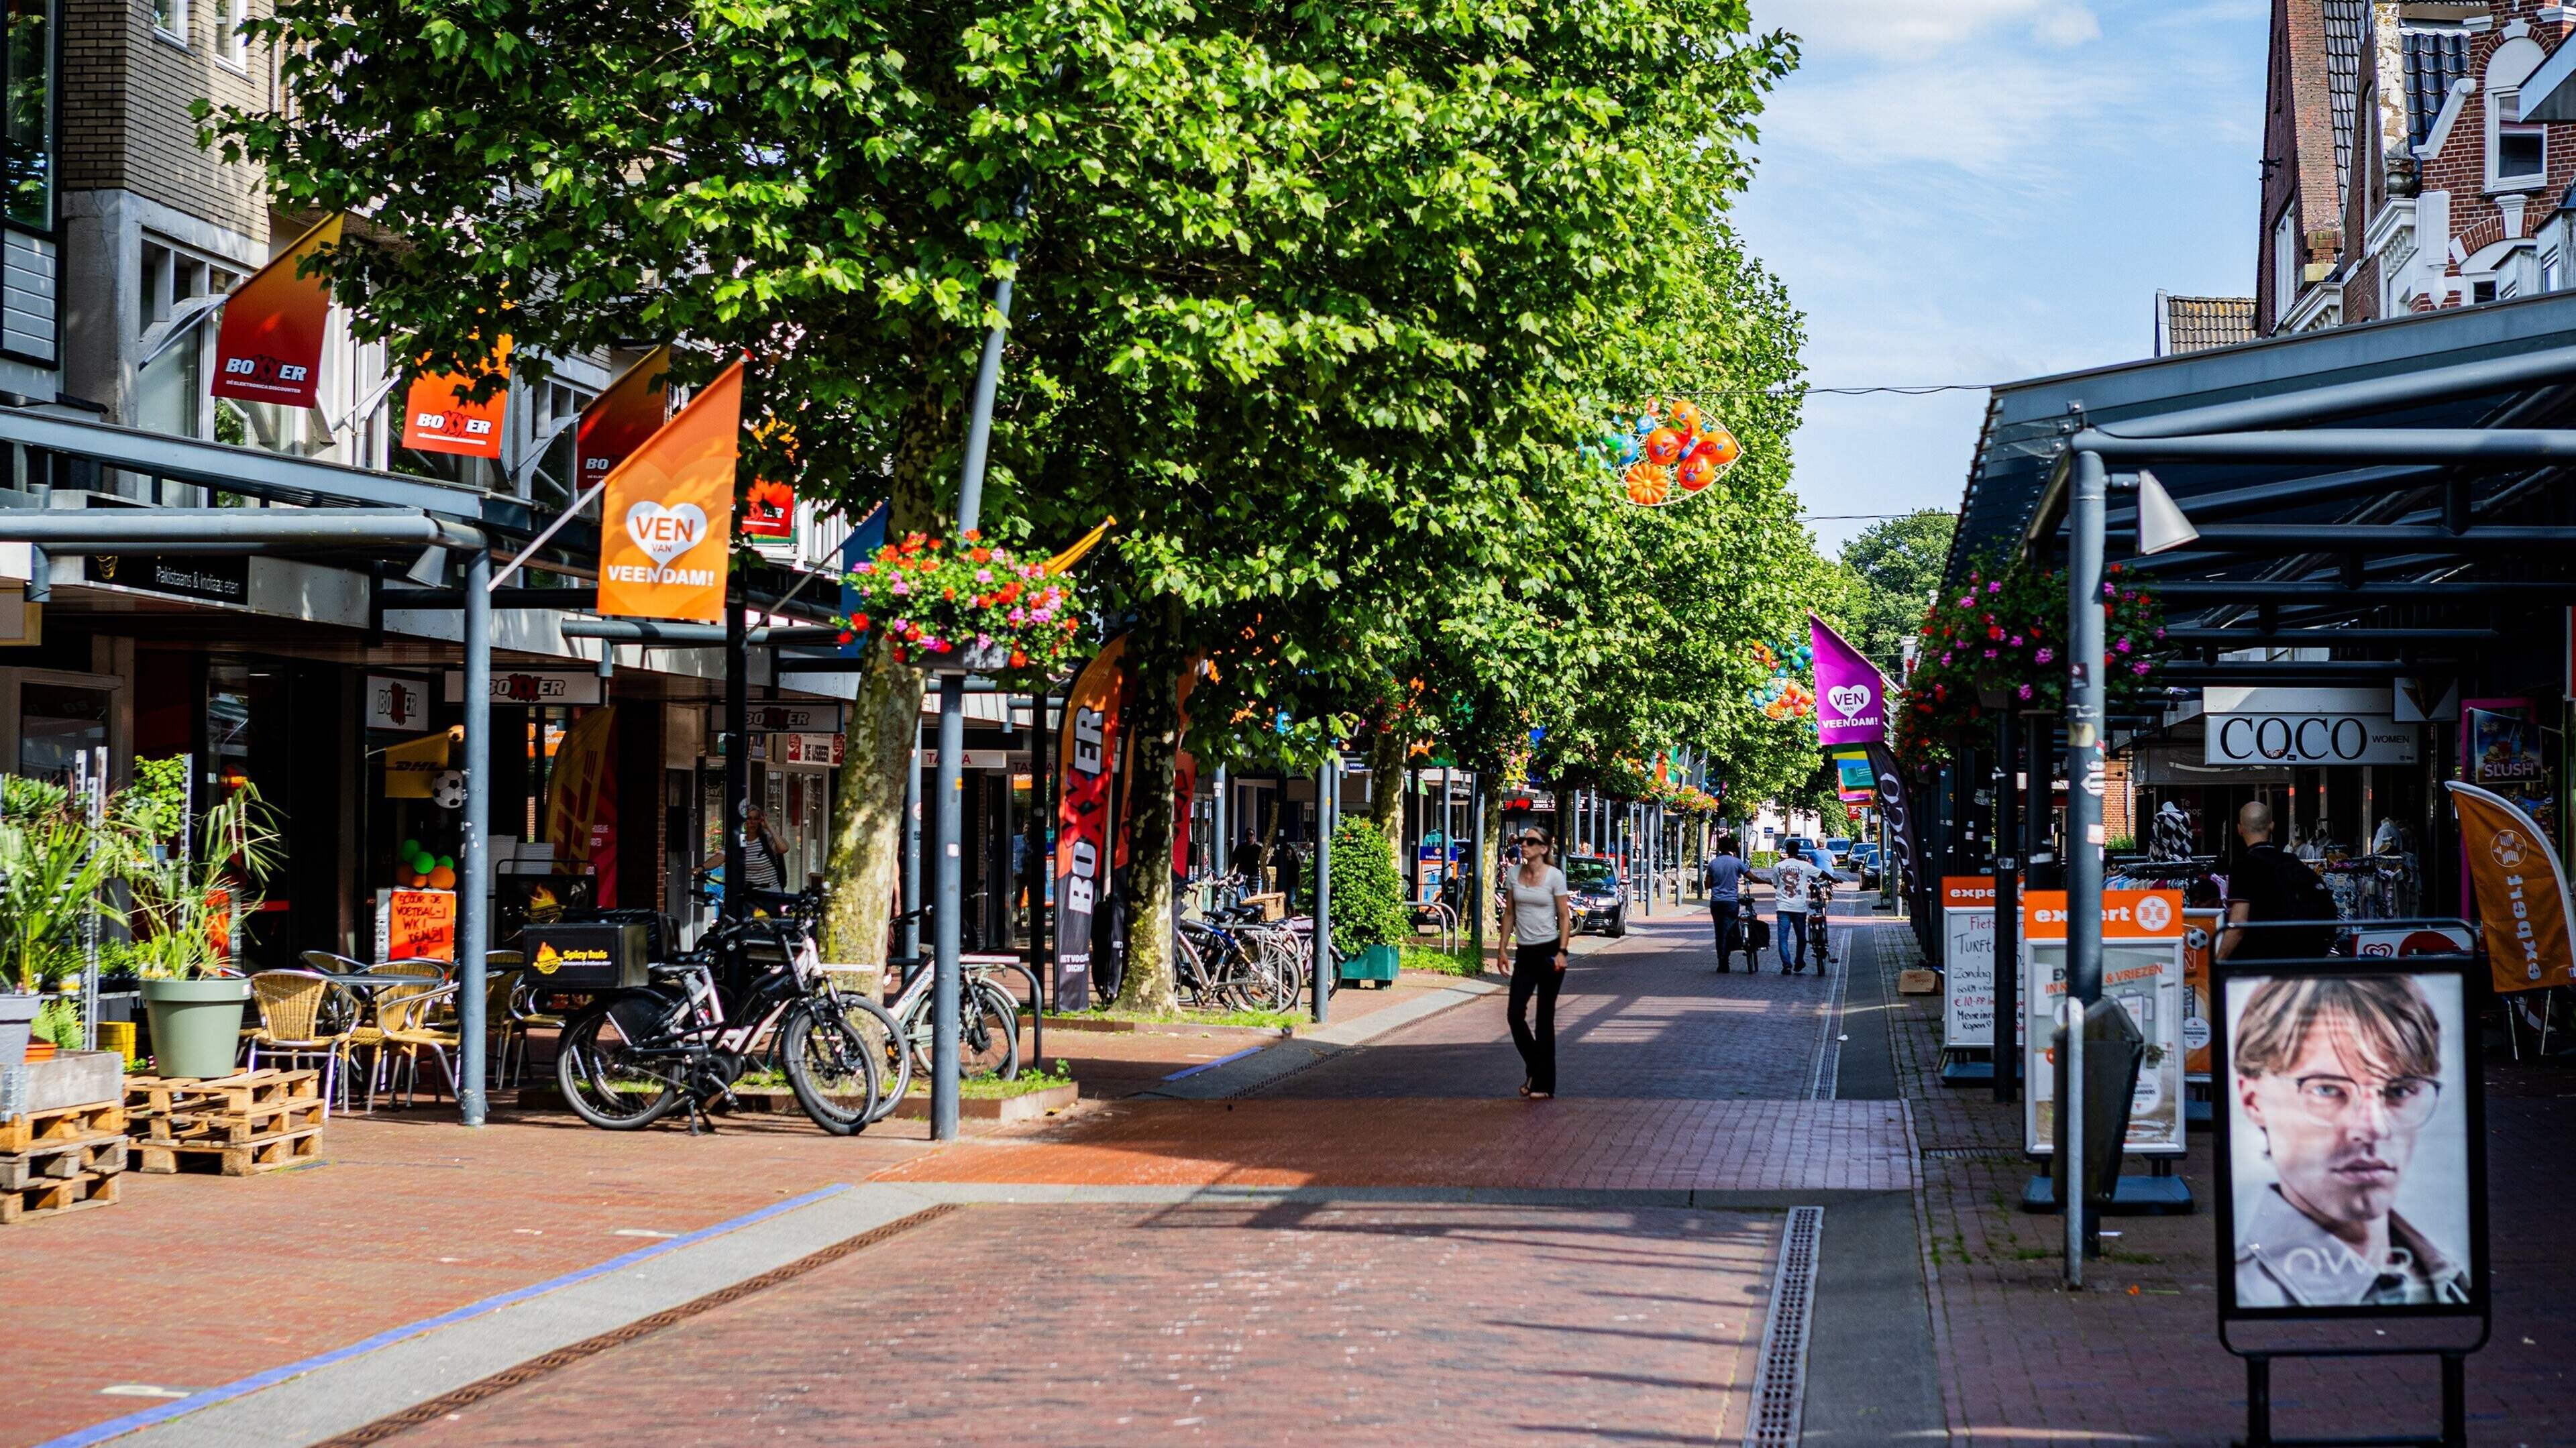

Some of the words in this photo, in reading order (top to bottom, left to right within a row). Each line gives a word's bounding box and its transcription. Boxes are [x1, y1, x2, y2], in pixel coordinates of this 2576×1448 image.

[225, 354, 307, 384] BOXXER
[416, 410, 492, 437] BOXXER
[635, 516, 694, 542] VEN
[652, 544, 672, 553] VAN
[156, 565, 192, 588] Pakistaans
[193, 571, 199, 588] &
[201, 573, 223, 592] Indiaas
[225, 579, 239, 595] eten
[608, 565, 714, 587] VEENDAM!
[378, 681, 417, 726] BOXXER
[1833, 692, 1864, 706] VEN
[1822, 717, 1878, 728] VEENDAM!
[2220, 718, 2367, 760] COCO
[2372, 735, 2410, 743] WOMEN
[1014, 762, 1055, 773] TASA
[2484, 762, 2534, 778] SLUSH
[1061, 706, 1108, 915] BOXXER
[1950, 889, 1996, 899] expe
[2034, 905, 2131, 923] exrt
[564, 950, 588, 961] Spicy
[588, 950, 608, 959] huis
[1953, 966, 1992, 985] Zondag
[2105, 975, 2114, 985] &
[2115, 964, 2163, 983] VRIEZEN
